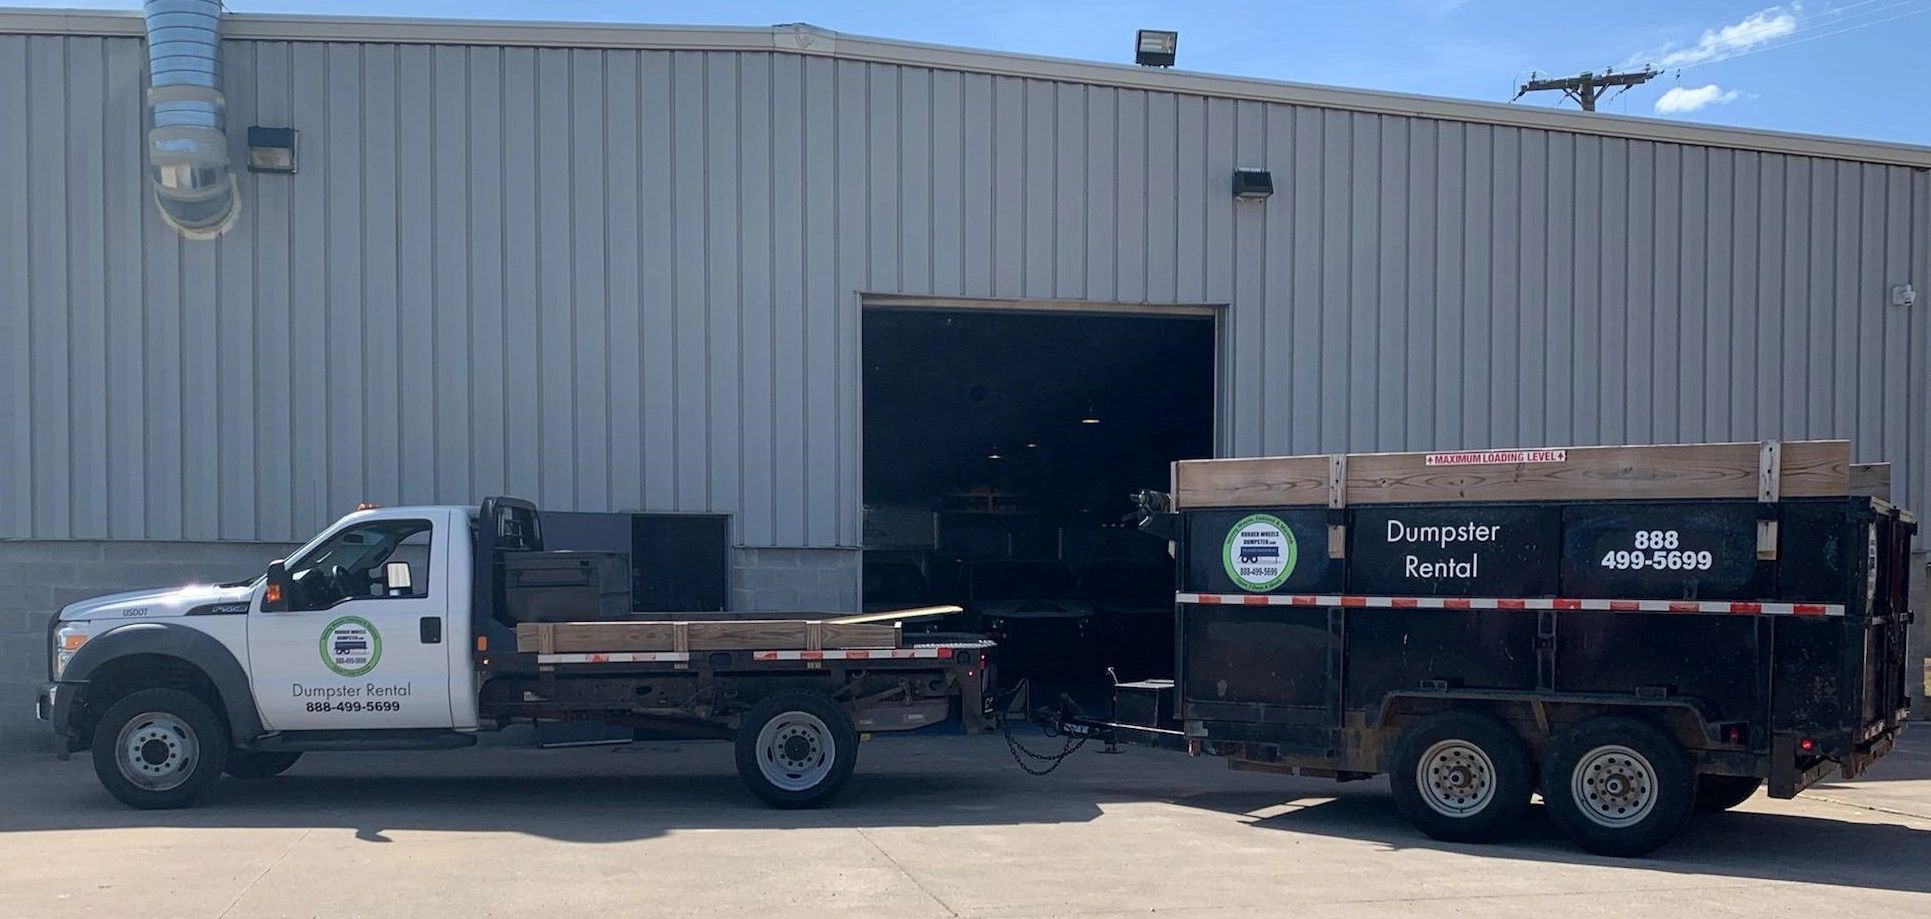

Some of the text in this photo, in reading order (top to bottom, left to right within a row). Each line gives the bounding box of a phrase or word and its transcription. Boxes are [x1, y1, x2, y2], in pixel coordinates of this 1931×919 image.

[1434, 450, 1556, 464] MAXIMUM LOADING LEVEL
[1387, 519, 1500, 549] Dumpster
[1634, 530, 1679, 550] 888
[1405, 552, 1478, 578] Rental
[1601, 550, 1713, 570] 499-5699
[1240, 567, 1278, 576] 888-499-5699
[122, 608, 148, 617] USDOT
[292, 682, 411, 700] Dumpster Rental
[306, 701, 400, 712] 888-499-5699
